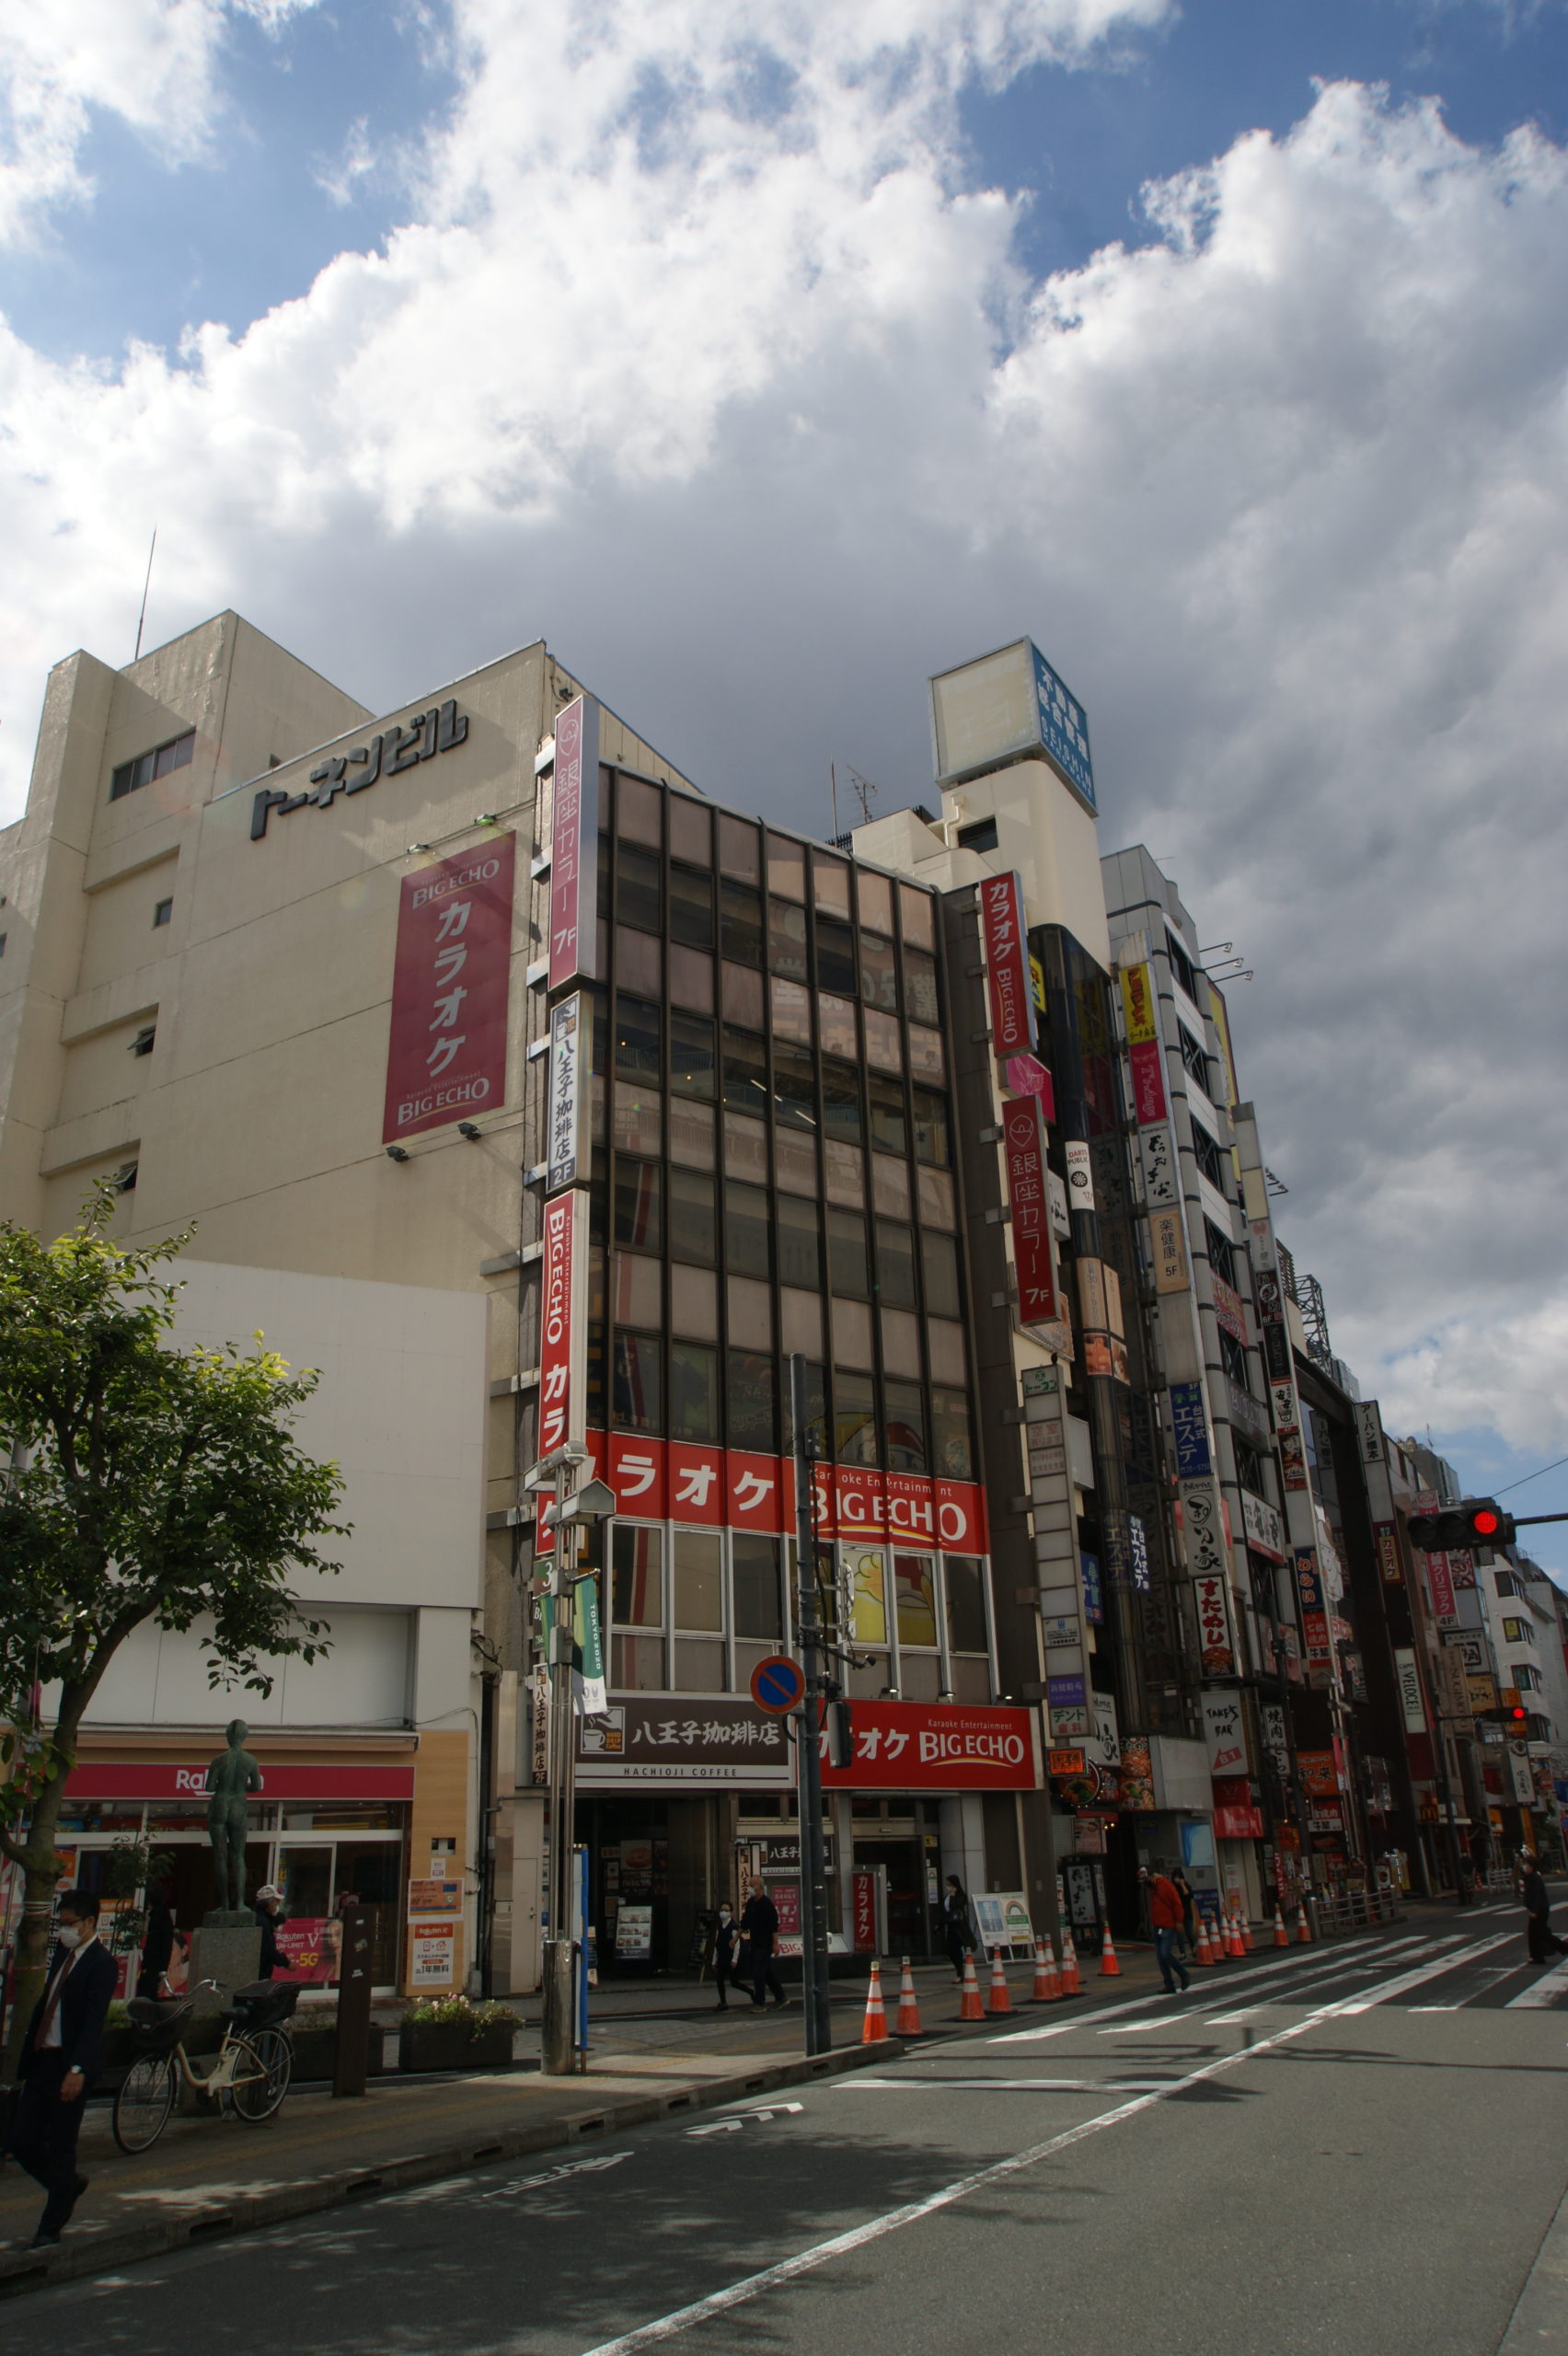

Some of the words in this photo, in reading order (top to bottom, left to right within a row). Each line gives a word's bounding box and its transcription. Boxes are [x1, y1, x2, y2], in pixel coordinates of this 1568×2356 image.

[250, 699, 468, 840] トーネンビル
[557, 758, 581, 912] 銀座カラー
[412, 876, 446, 910] BIG
[449, 859, 500, 889] ECHO
[554, 926, 577, 955] 7F
[989, 882, 1015, 962] カラオケ
[426, 901, 472, 1078] カラオケ
[996, 967, 1013, 998] BIG
[1001, 1000, 1018, 1044] ECHO
[398, 1095, 432, 1126] BIG
[436, 1078, 490, 1106] ECHO
[554, 1039, 575, 1161] 八王子珈琲店
[553, 1162, 572, 1186] 2F
[1011, 1151, 1040, 1275] 銀座カラー
[549, 1207, 565, 1262] BIG
[1159, 1218, 1176, 1260] 楽健康
[1165, 1265, 1178, 1277] 5F
[547, 1265, 563, 1345] ECHO
[1025, 1288, 1050, 1305] 7F
[1174, 1405, 1198, 1464] エステ
[811, 1468, 862, 1485] Karoke
[868, 1474, 952, 1496] Entertainmnt
[872, 1496, 967, 1542] ECHO
[1383, 1540, 1398, 1577] カラオケ
[590, 1603, 599, 1642] TOKYO
[1198, 1579, 1225, 1645] すためし
[1440, 1616, 1455, 1625] 4F
[594, 1643, 602, 1670] 2020
[1402, 1671, 1419, 1706] VELOCE
[535, 1684, 547, 1771] 八王子珈琲店
[631, 1720, 780, 1748] 八王子珈琲店
[928, 1717, 959, 1729] Karaoke
[961, 1719, 1013, 1731] Entertainment
[1053, 1708, 1085, 1723] デント
[919, 1731, 962, 1762] BIG
[966, 1734, 1024, 1764] ECHO
[1219, 1750, 1237, 1764] B1
[534, 1772, 547, 1784] 2F
[624, 1767, 685, 1777] HACHIOJI
[692, 1768, 737, 1777] COFFEE
[858, 1875, 870, 1939] カラオケ
[299, 1952, 319, 1967] 5G
[422, 1964, 449, 1974] 1年無料
